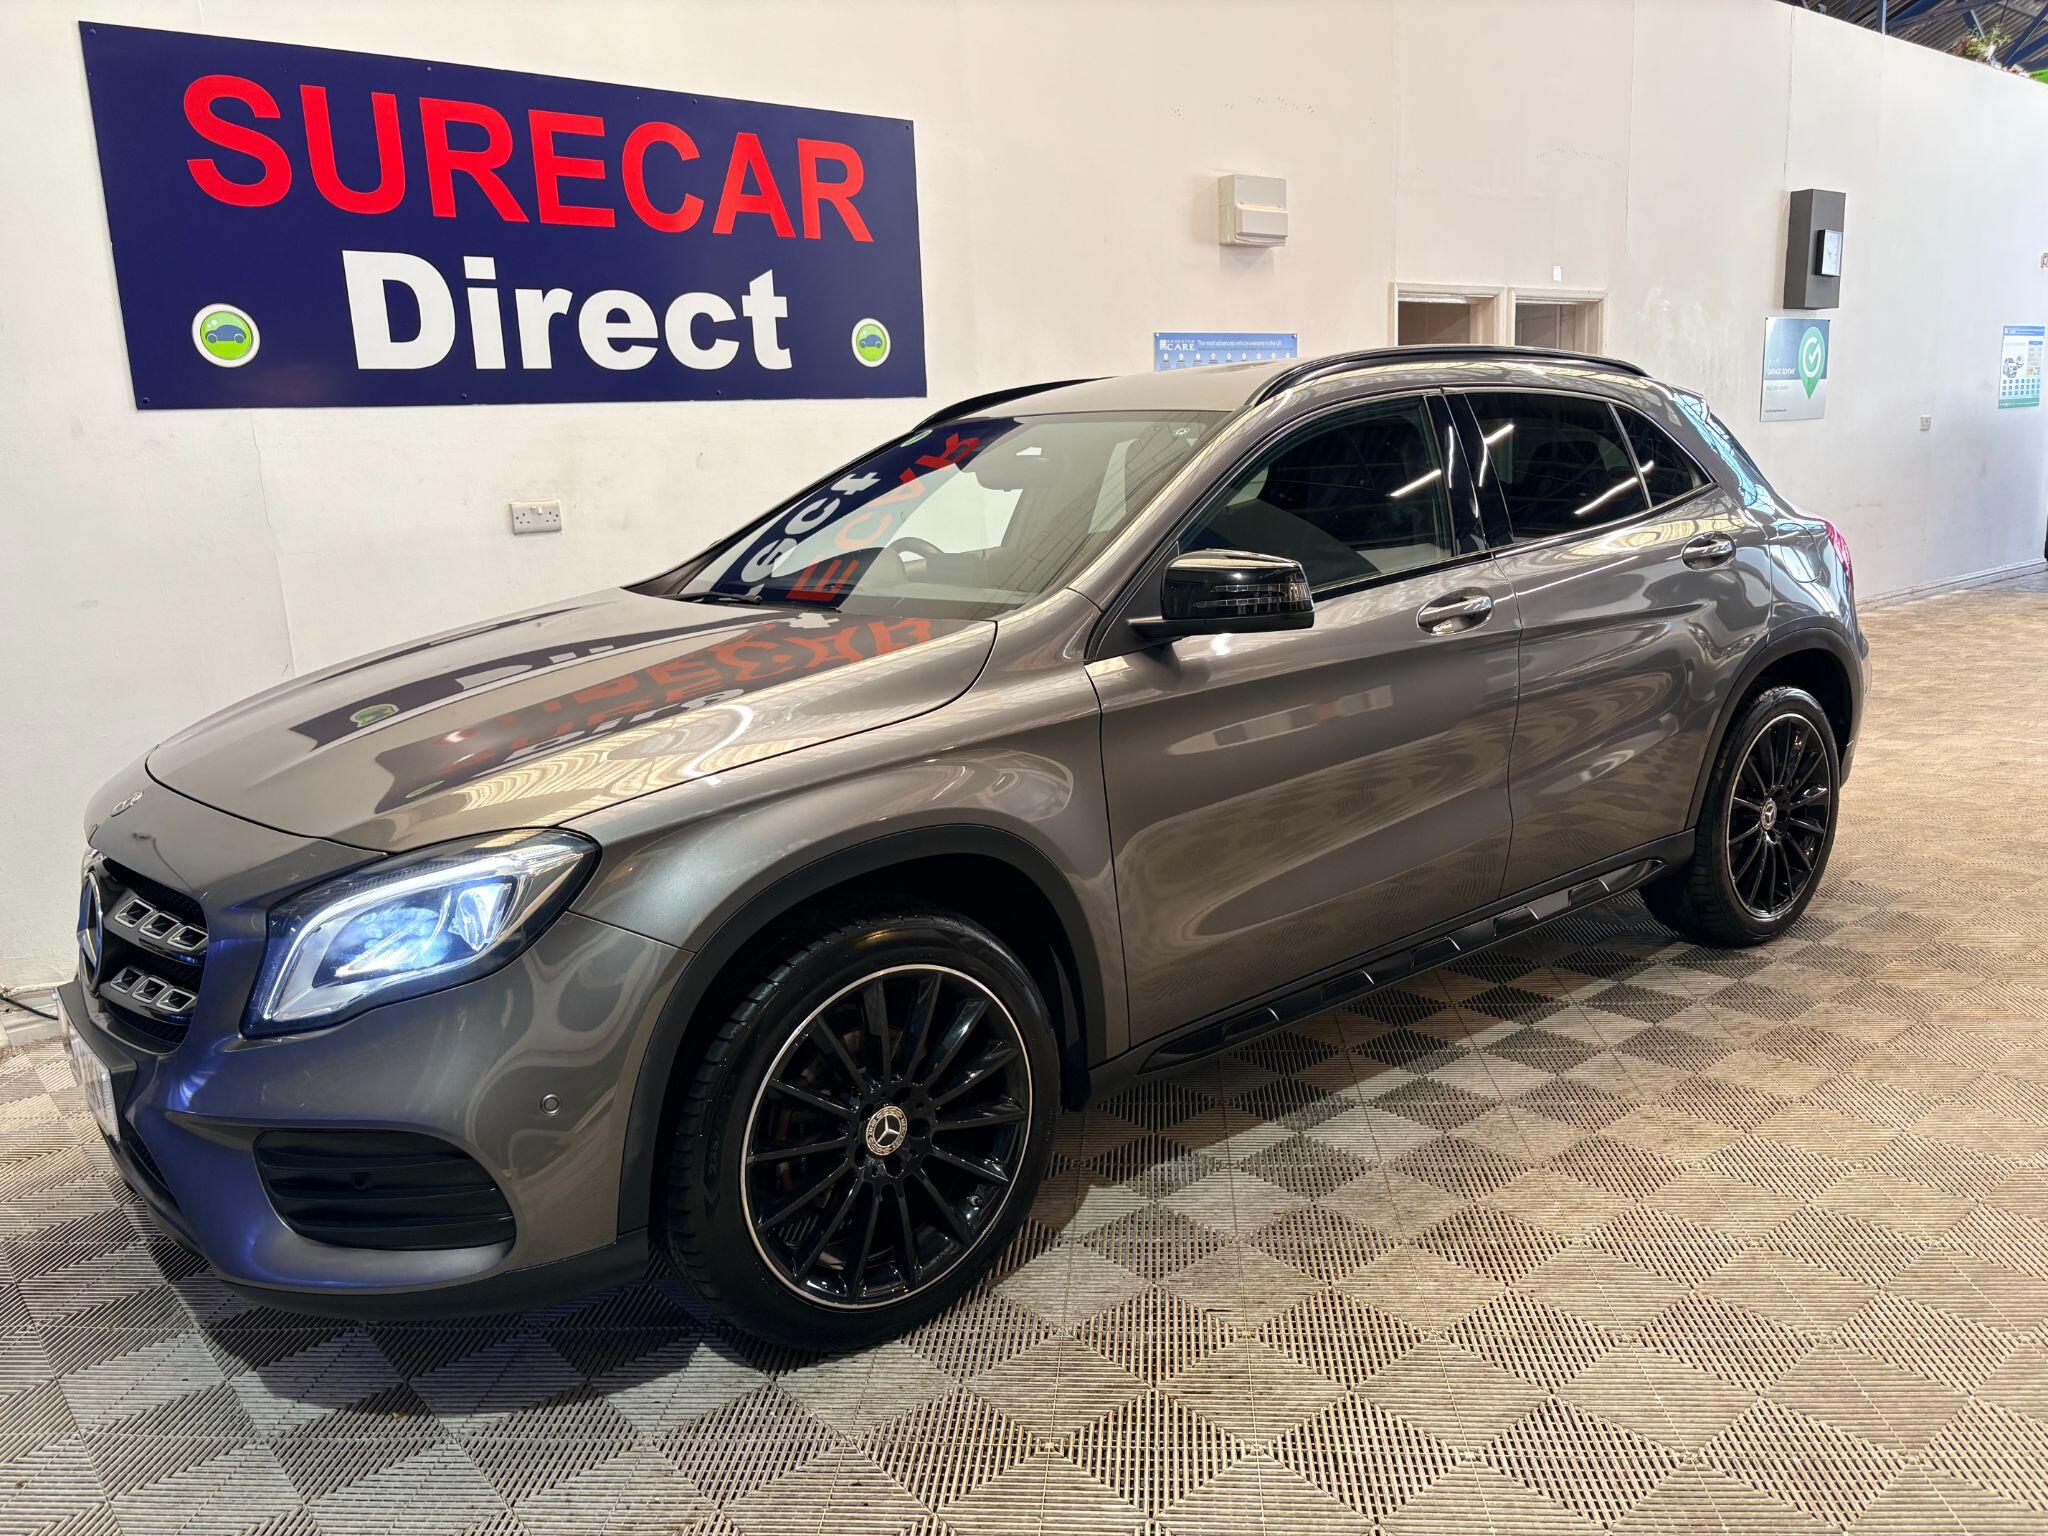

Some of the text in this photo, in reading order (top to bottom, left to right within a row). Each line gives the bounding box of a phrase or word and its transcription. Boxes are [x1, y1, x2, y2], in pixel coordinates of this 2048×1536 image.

[183, 75, 874, 242] SURECAR
[342, 250, 792, 370] Direct
[1166, 343, 1196, 351] CARE
